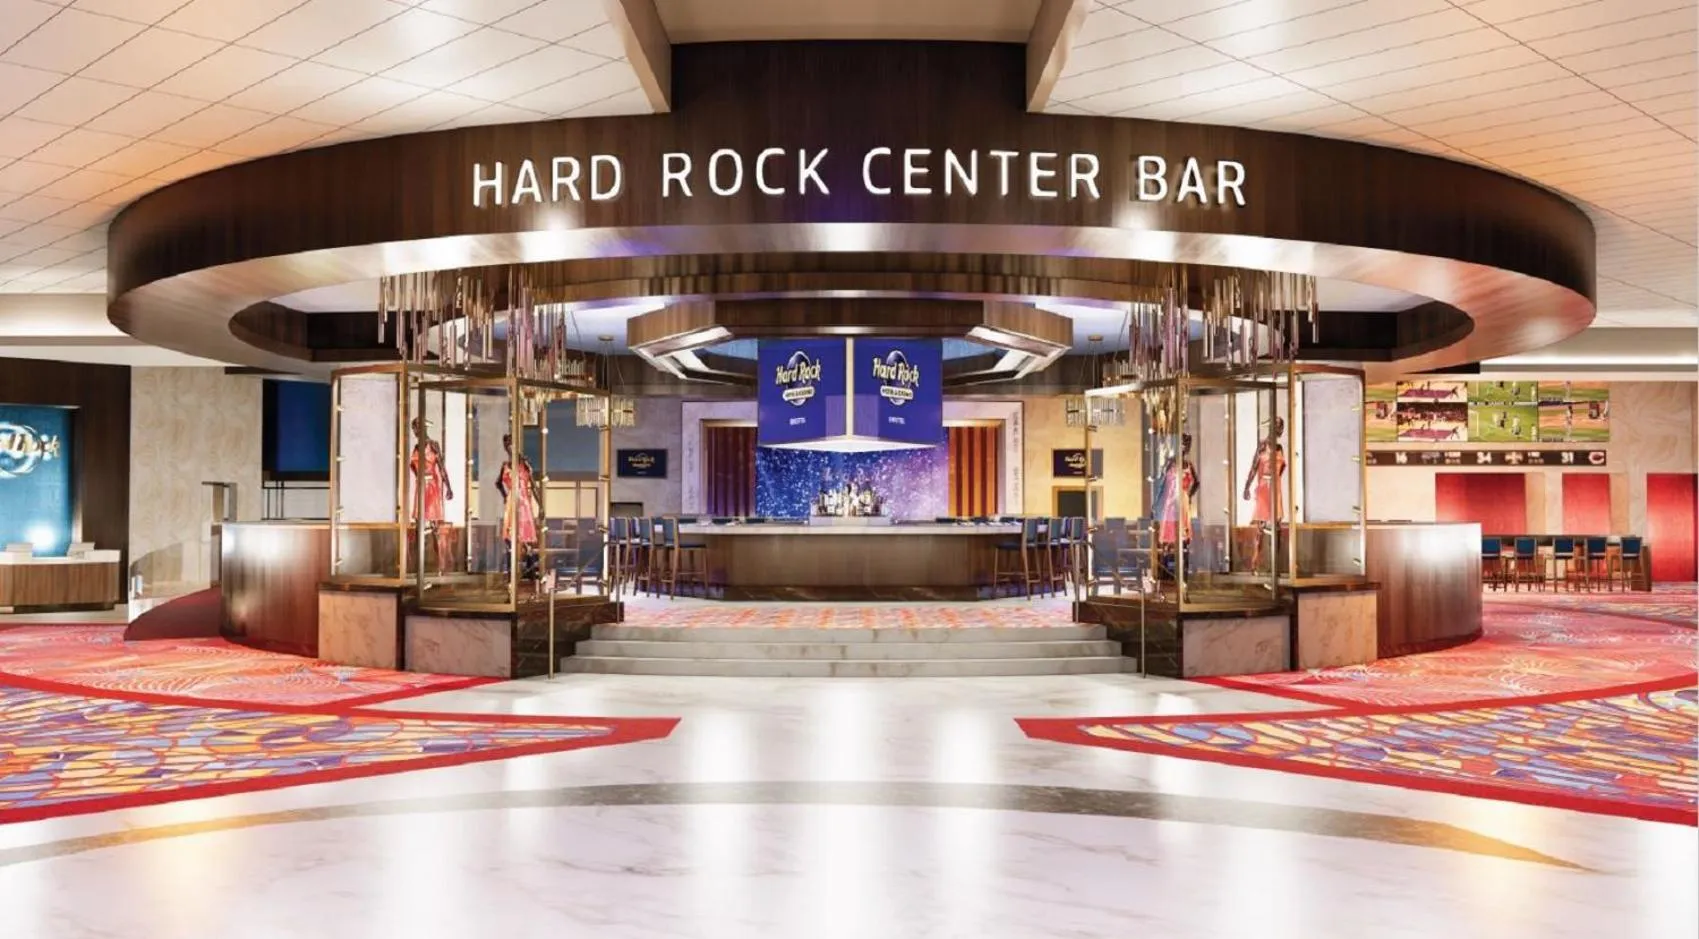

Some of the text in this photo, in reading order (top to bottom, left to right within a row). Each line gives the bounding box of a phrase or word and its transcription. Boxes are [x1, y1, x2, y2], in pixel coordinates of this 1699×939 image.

[473, 147, 1246, 207] HARD ROCK CENTER BAR
[775, 359, 821, 385] Hard Rock
[872, 357, 919, 387] Hard Rock
[1395, 452, 1408, 464] 16
[1477, 451, 1492, 464] 34
[1561, 451, 1574, 464] 31
